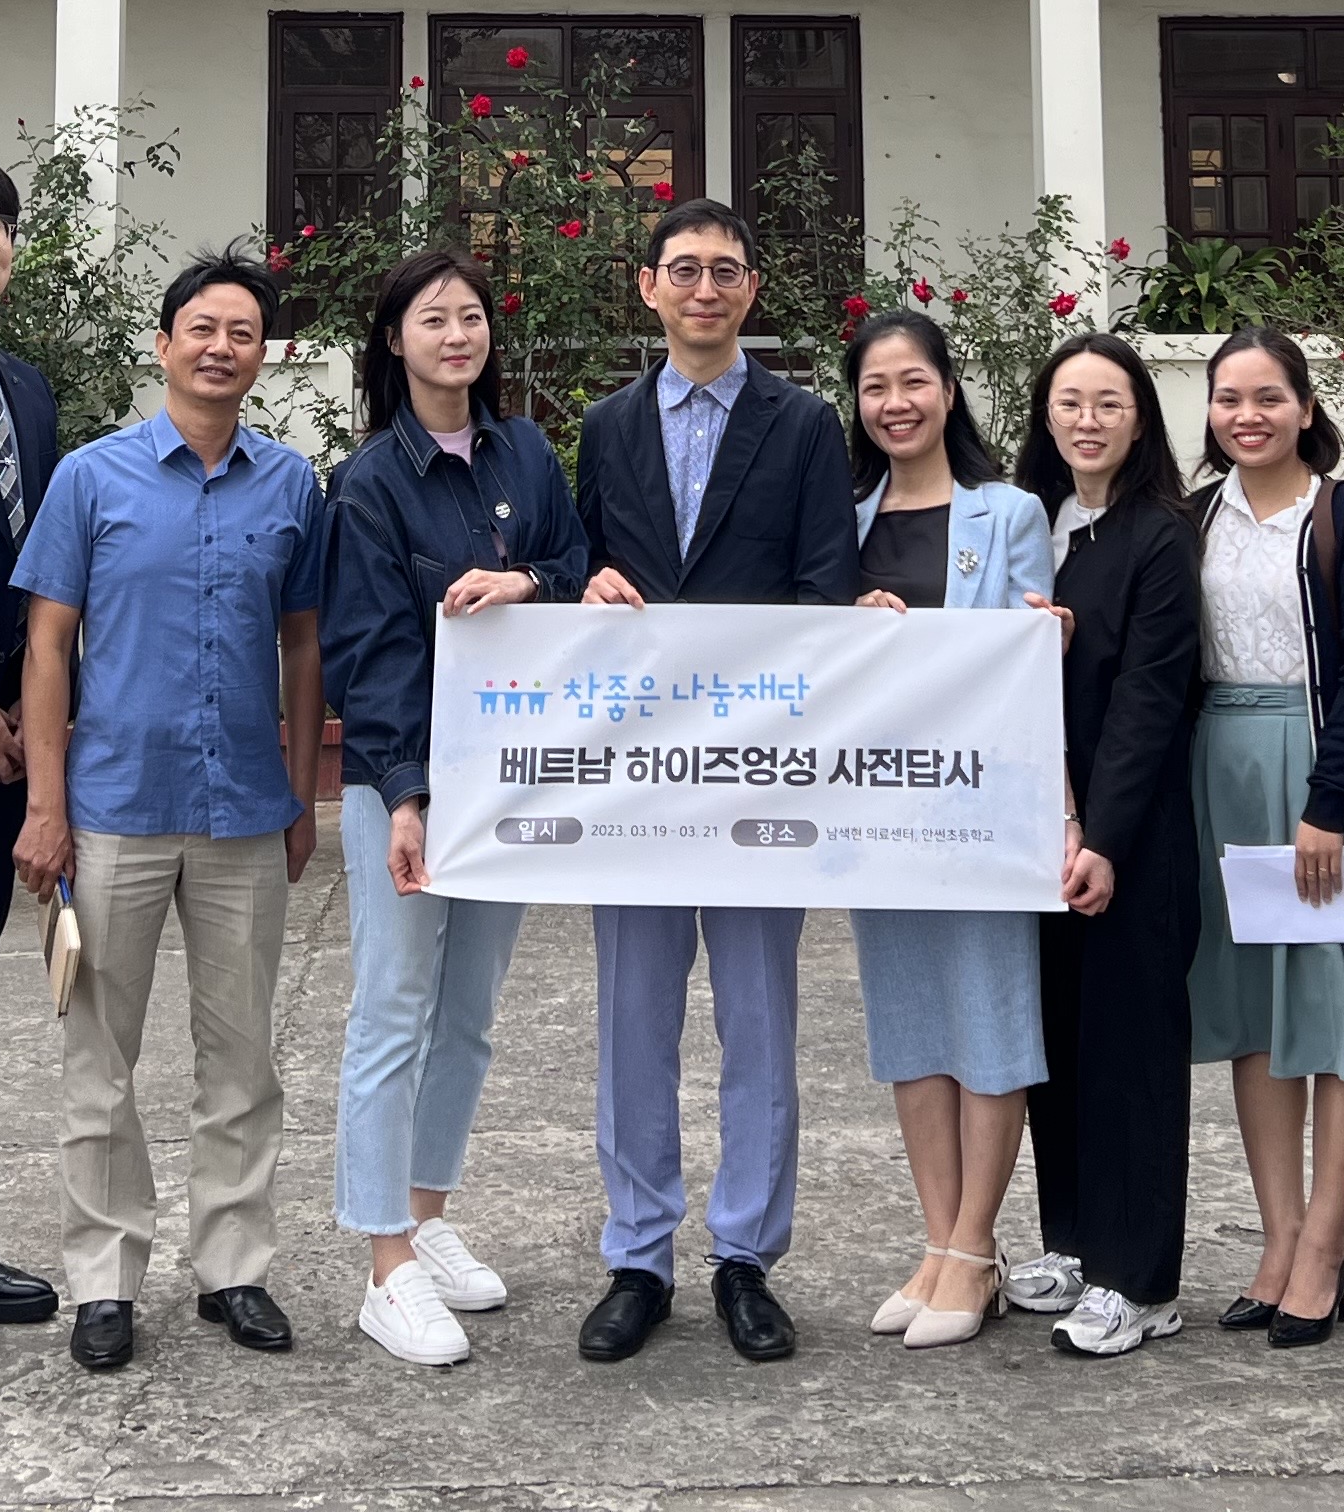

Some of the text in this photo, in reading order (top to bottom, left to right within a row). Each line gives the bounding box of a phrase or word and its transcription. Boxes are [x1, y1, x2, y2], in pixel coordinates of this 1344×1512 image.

[563, 672, 810, 722] 참좋은 나눔재단
[499, 746, 984, 789] 베트남 하이즈엉성 사전답사
[519, 820, 557, 843] 일시
[703, 825, 718, 838] 21
[756, 822, 797, 844] 장소
